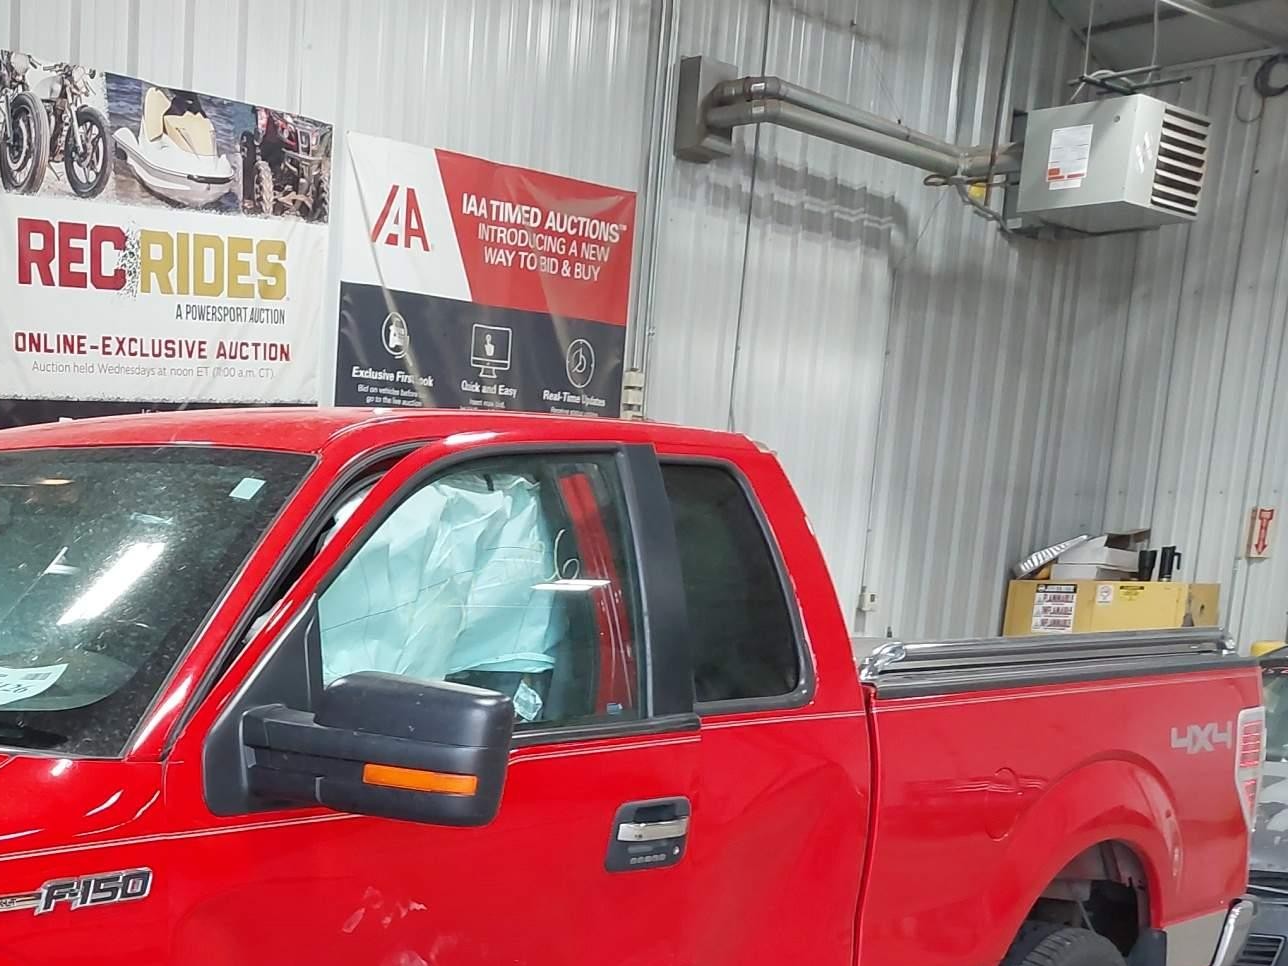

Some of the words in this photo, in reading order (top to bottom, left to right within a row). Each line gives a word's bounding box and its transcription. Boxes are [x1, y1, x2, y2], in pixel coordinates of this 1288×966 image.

[462, 192, 488, 219] IAA
[490, 200, 541, 227] TIMED
[478, 222, 566, 254] INTRODUCING
[569, 243, 577, 257] A
[581, 244, 610, 262] NEW
[18, 217, 127, 291] REC
[140, 228, 287, 300] RIDES
[483, 246, 516, 267] WAY
[518, 252, 538, 271] TO
[540, 256, 559, 275] BID
[561, 262, 571, 277] &
[574, 263, 601, 281] BUY
[175, 304, 183, 320] A
[185, 304, 248, 323] POWERSPORT
[249, 307, 286, 325] AUCTION
[14, 332, 207, 359] ONLINE-EXCLUSIVE
[216, 342, 291, 362] AUCTION
[32, 361, 71, 374] Auction
[73, 362, 94, 374] held
[98, 363, 156, 378] Wednesdays
[158, 365, 167, 377] at
[170, 367, 193, 377] noon
[196, 366, 210, 377] ET
[352, 366, 394, 382] Exclusive
[461, 379, 481, 393] Quick
[481, 384, 497, 394] and
[498, 384, 518, 399] Easy
[542, 389, 581, 404] Real-Time
